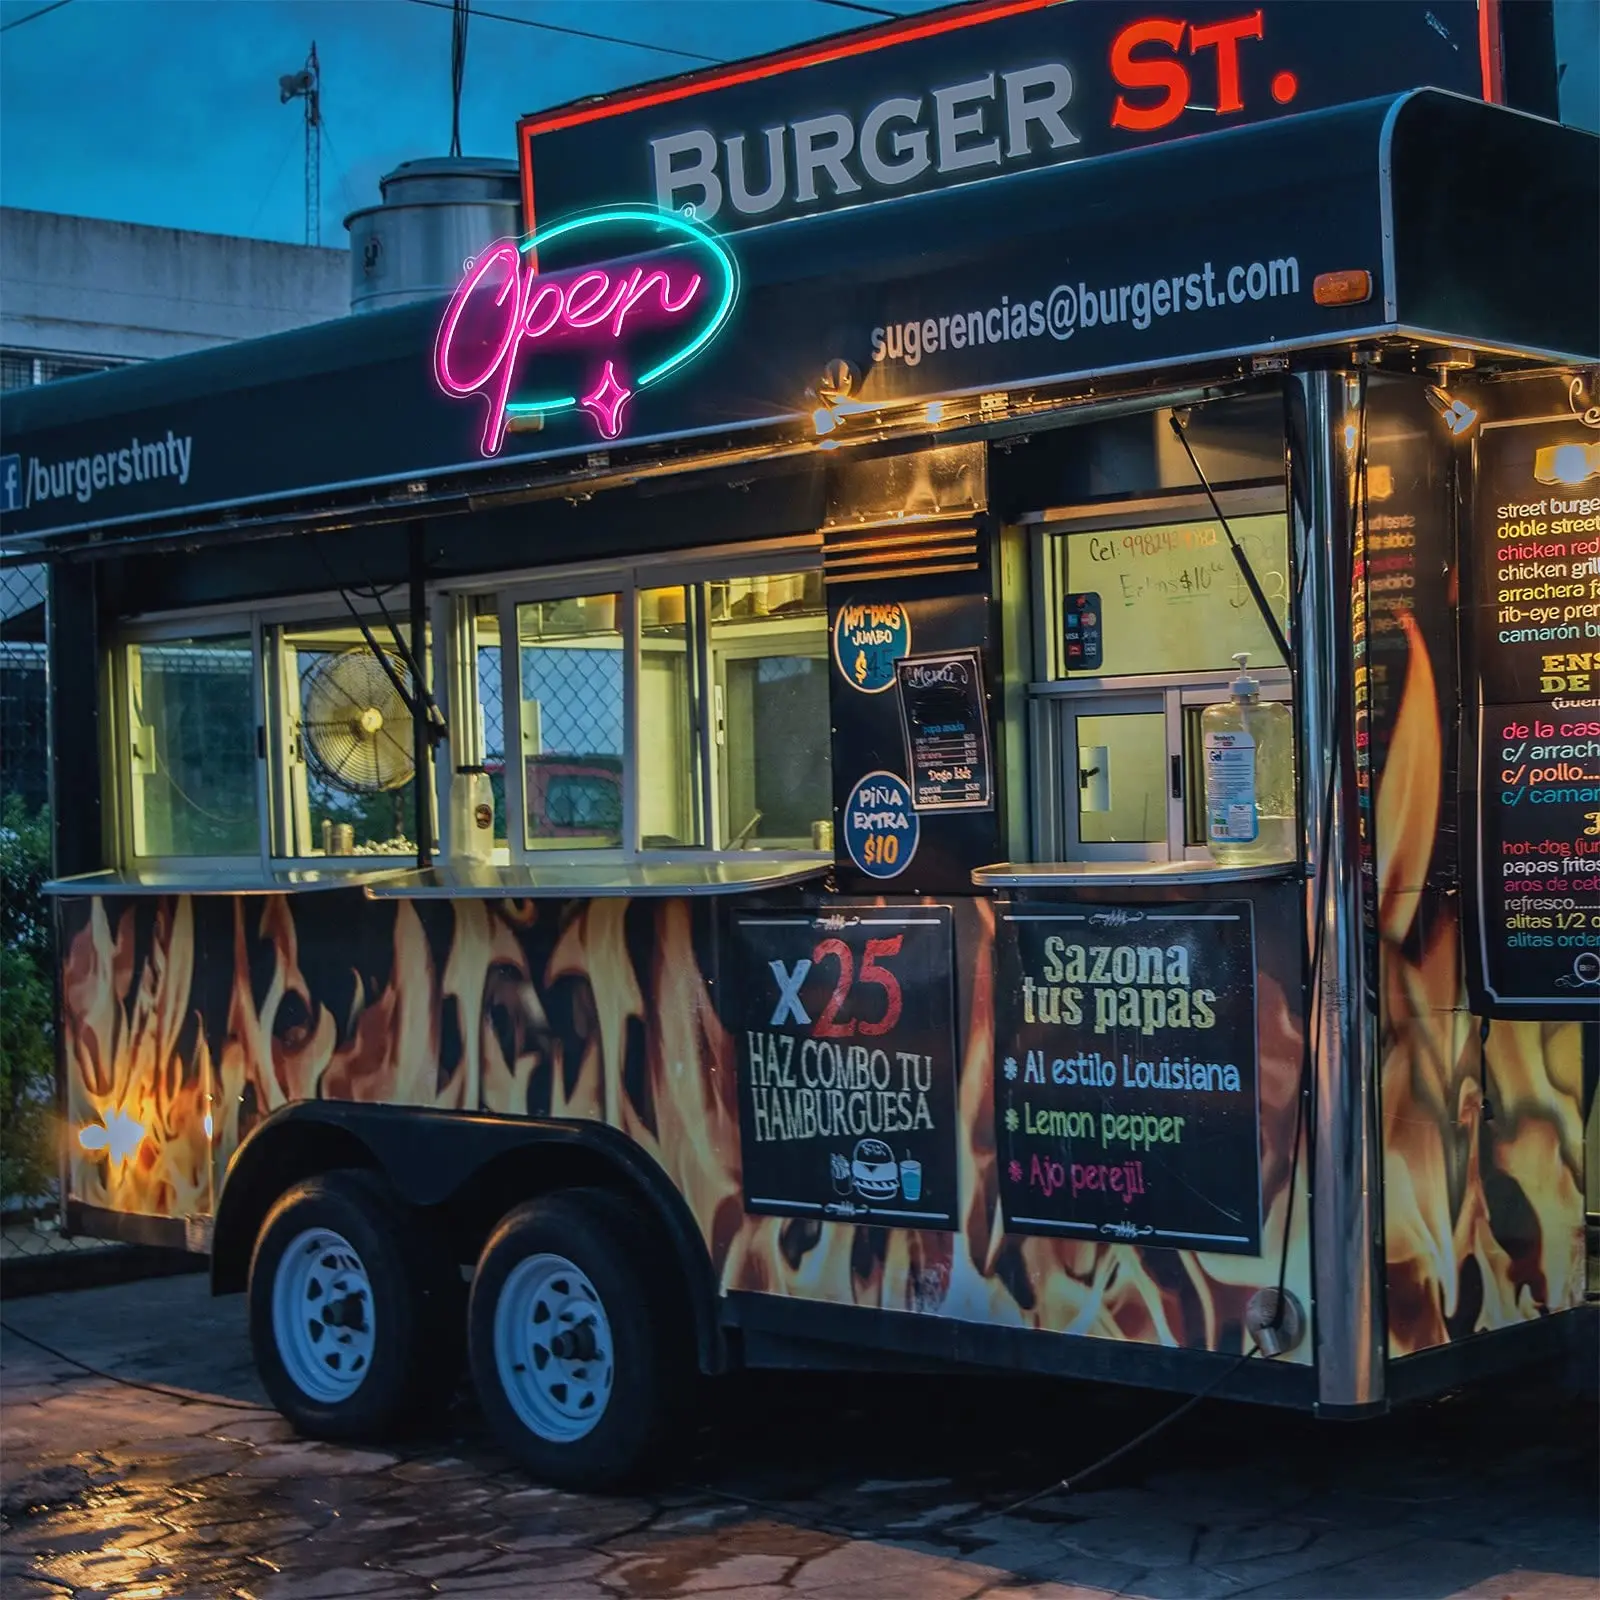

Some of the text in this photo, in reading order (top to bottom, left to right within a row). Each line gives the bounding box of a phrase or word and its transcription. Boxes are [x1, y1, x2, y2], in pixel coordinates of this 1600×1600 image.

[650, 10, 1299, 229] BURGER ST.
[871, 256, 1301, 367] sugerencias@burgerst.com
[439, 243, 701, 453] Open
[26, 430, 192, 508] /burgerstmty
[1497, 500, 1547, 519] street
[1497, 519, 1548, 539] doble
[1497, 541, 1566, 561] chicken
[1498, 562, 1567, 581] chicken
[1498, 583, 1585, 602] arrachera
[1498, 605, 1560, 624] rib-eye
[852, 629, 893, 647] JUMBO
[1499, 622, 1580, 643] camarón
[1539, 674, 1591, 693] DE
[1503, 722, 1529, 740] de
[1534, 720, 1555, 738] la
[1502, 742, 1526, 763] c/
[1501, 764, 1526, 785] c/
[1501, 786, 1526, 807] c/
[854, 811, 910, 830] EXTRA
[864, 833, 899, 866] $10
[1502, 840, 1572, 857] hot-dog
[1503, 860, 1559, 877] papas
[1504, 880, 1543, 892] aros
[1547, 877, 1568, 891] de
[1505, 912, 1553, 929] alitas
[1555, 911, 1587, 930] 1/2
[1507, 932, 1555, 948] alitas
[1043, 936, 1190, 985] Sazona
[1022, 976, 1217, 1035] tus papas
[747, 1030, 933, 1092] HAZ COMBO TU
[1024, 1050, 1241, 1092] Al estilo Louisiana
[751, 1086, 935, 1142] HAMBURGUESA
[1024, 1101, 1186, 1152] Lemon pepper
[1029, 1153, 1145, 1204] Ajo perejil
